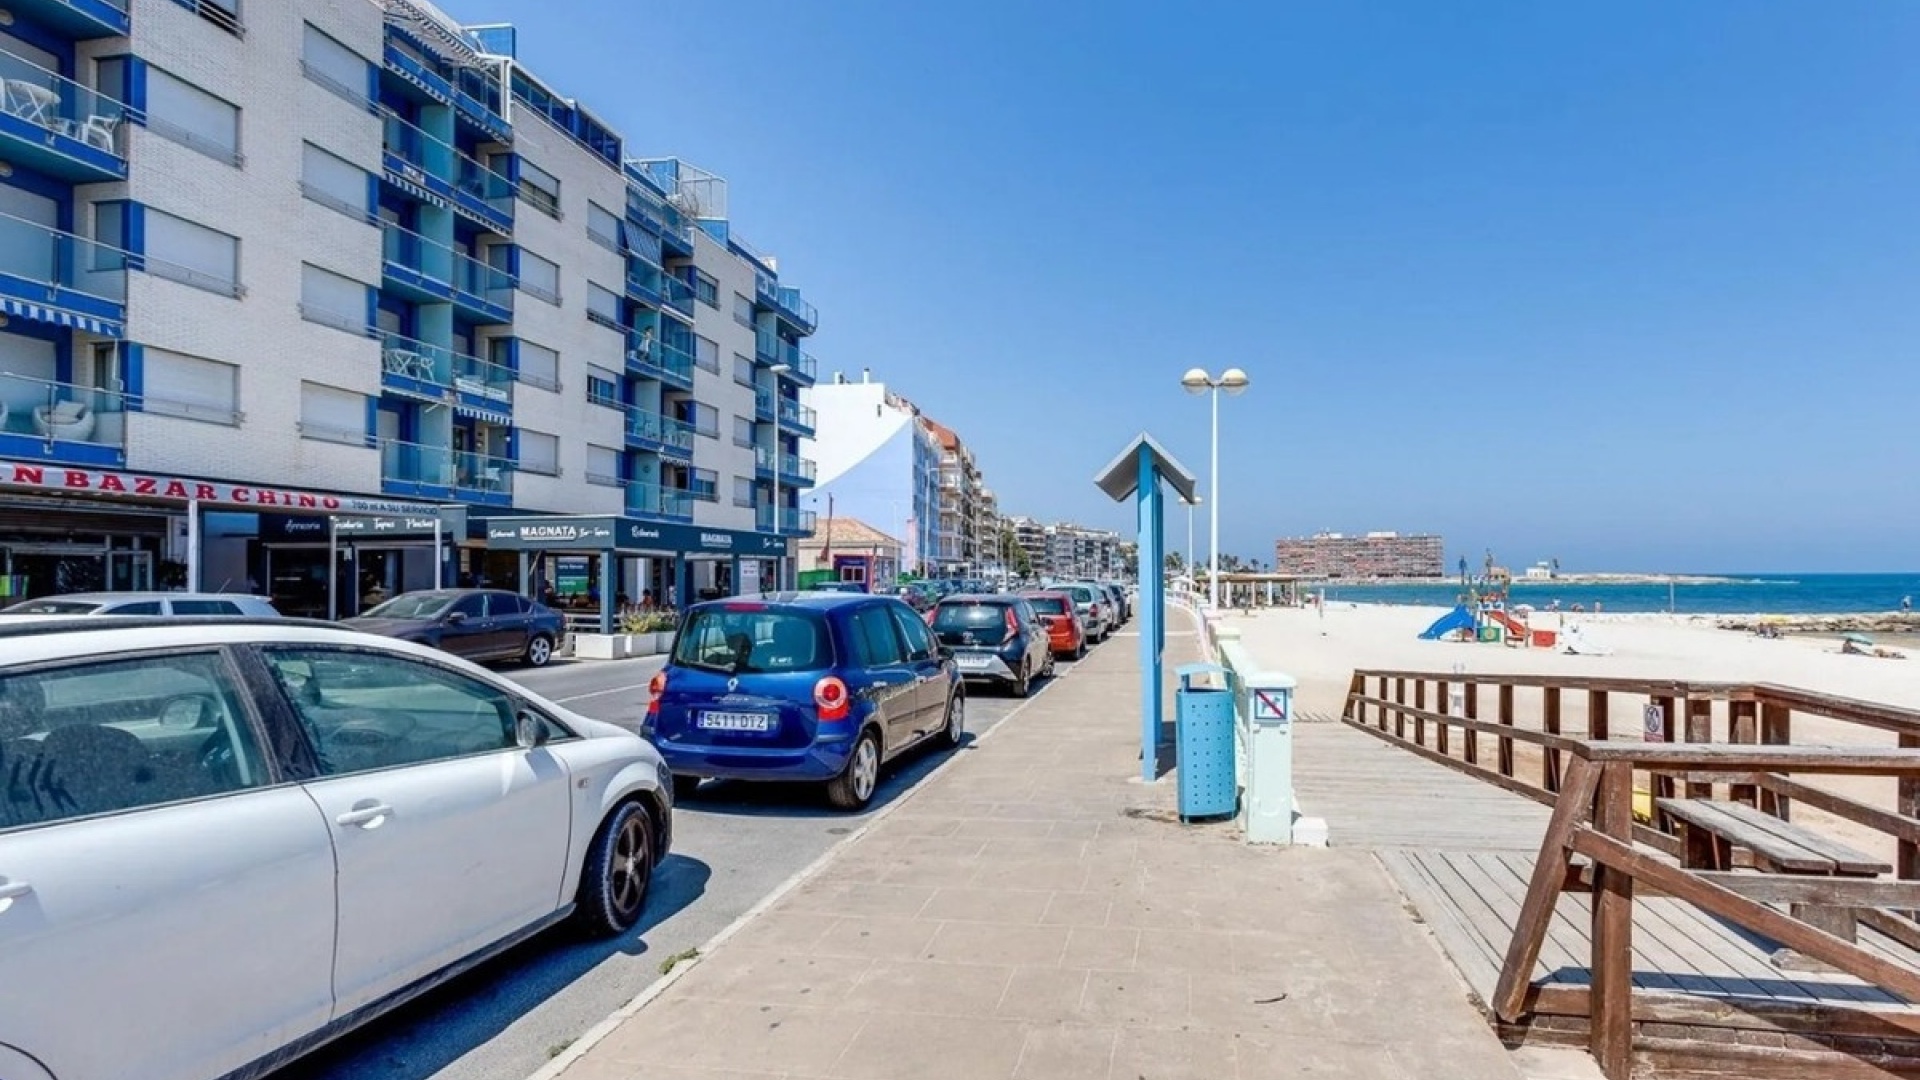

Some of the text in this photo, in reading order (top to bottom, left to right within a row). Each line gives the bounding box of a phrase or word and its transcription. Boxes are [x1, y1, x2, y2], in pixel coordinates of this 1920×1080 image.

[65, 471, 217, 500] BAZAR
[231, 488, 340, 509] CHINO
[519, 525, 577, 537] MAGNATA
[706, 714, 736, 727] 5411
